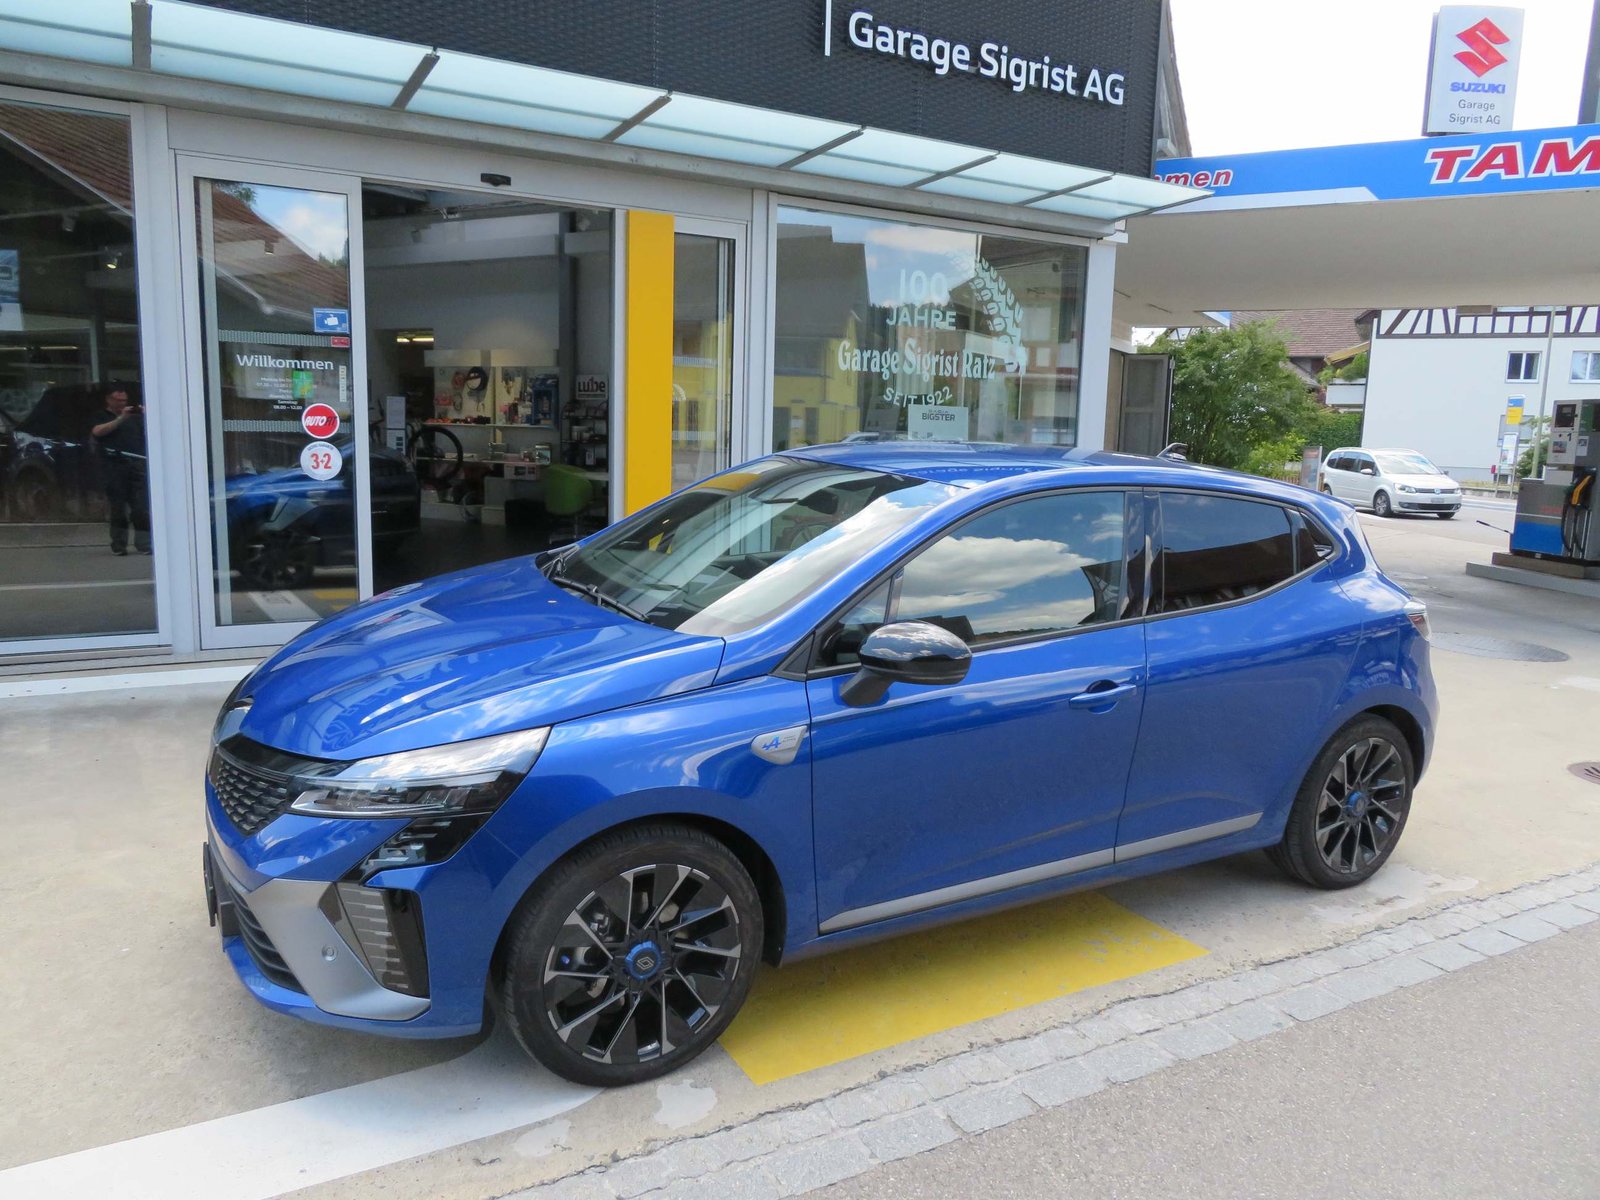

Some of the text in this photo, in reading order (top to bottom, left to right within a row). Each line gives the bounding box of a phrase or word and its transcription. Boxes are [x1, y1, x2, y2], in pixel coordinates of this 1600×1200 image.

[849, 11, 1125, 105] Garage Sigrist AG
[1450, 82, 1506, 94] SUZUKI
[1458, 99, 1495, 111] Garage
[1449, 113, 1501, 125] Sigrist AG
[1154, 169, 1233, 188] men
[900, 268, 948, 302] 100
[886, 305, 956, 331] JAHRE
[236, 354, 334, 370] Willkommen
[837, 339, 899, 380] Garage
[902, 337, 959, 382] Sigrist
[883, 386, 953, 408] SEIT 1922
[922, 413, 955, 421] BIGSTER
